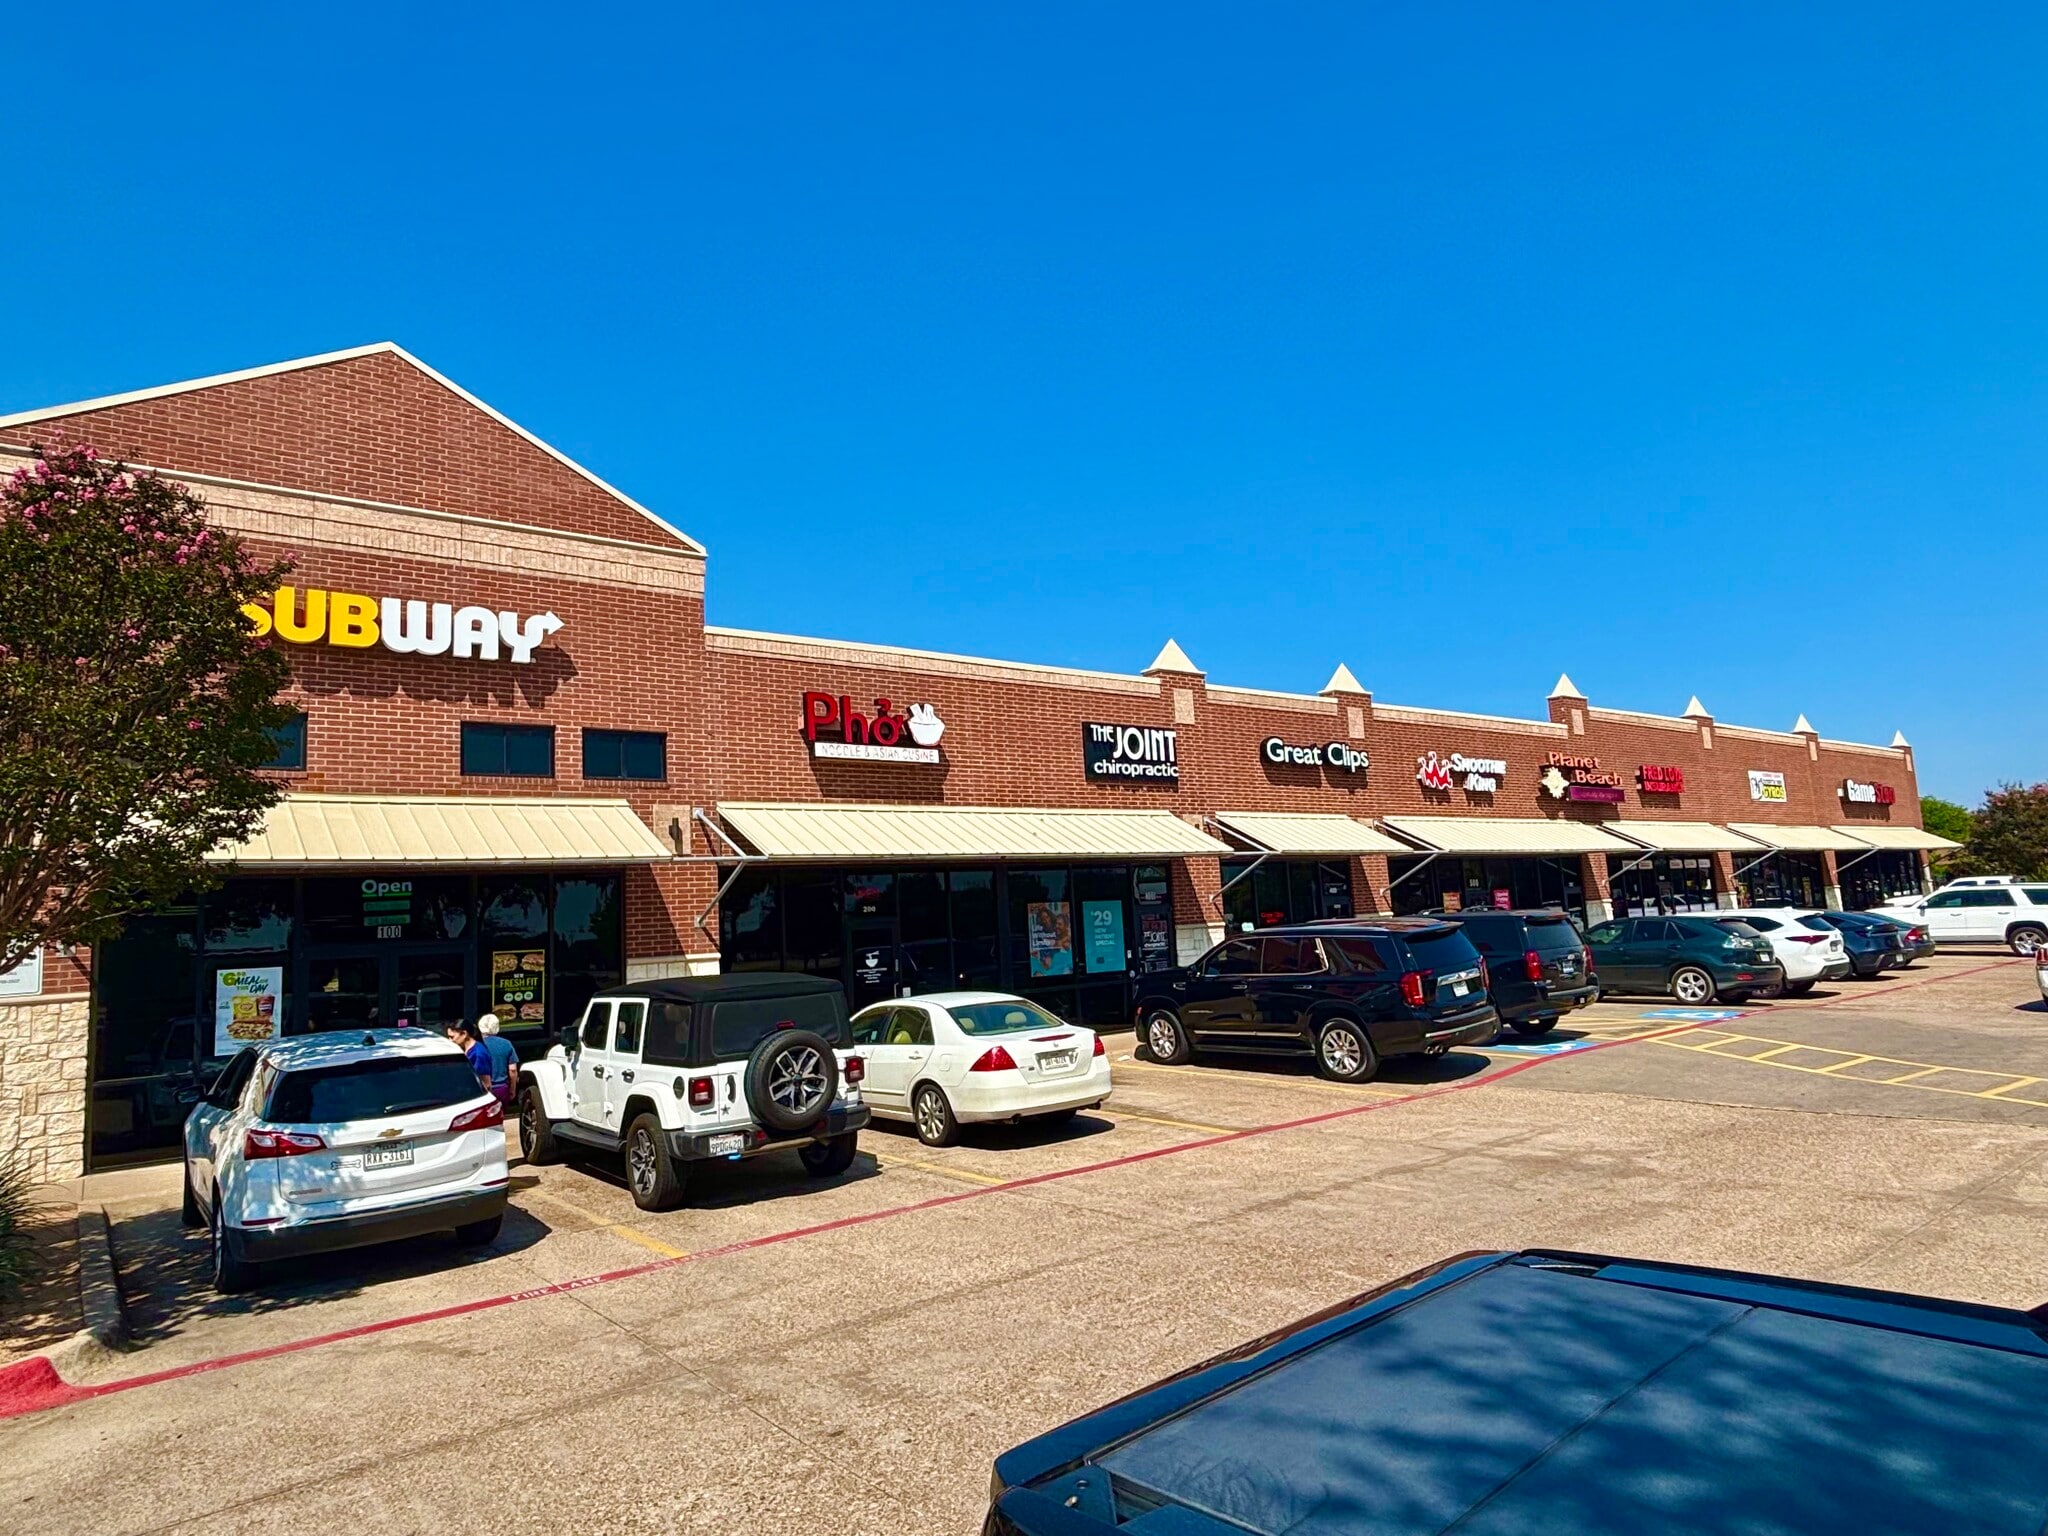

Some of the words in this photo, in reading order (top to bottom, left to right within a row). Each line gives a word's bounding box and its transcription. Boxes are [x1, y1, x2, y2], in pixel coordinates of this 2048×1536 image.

[1090, 724, 1115, 743] THE
[1113, 726, 1177, 762] JOINT
[822, 744, 861, 758] NOODLE
[874, 747, 899, 760] ASIAN
[1266, 737, 1323, 765] Great
[1327, 743, 1369, 773] Clips
[1094, 759, 1180, 778] chiropractic
[1549, 752, 1600, 769] Planet
[1574, 769, 1622, 785] Beach
[361, 879, 413, 897] Open
[377, 925, 402, 939] 100
[235, 976, 260, 986] MEAL
[249, 983, 269, 993] DAY
[500, 979, 525, 988] FRESH
[526, 977, 539, 987] FIT
